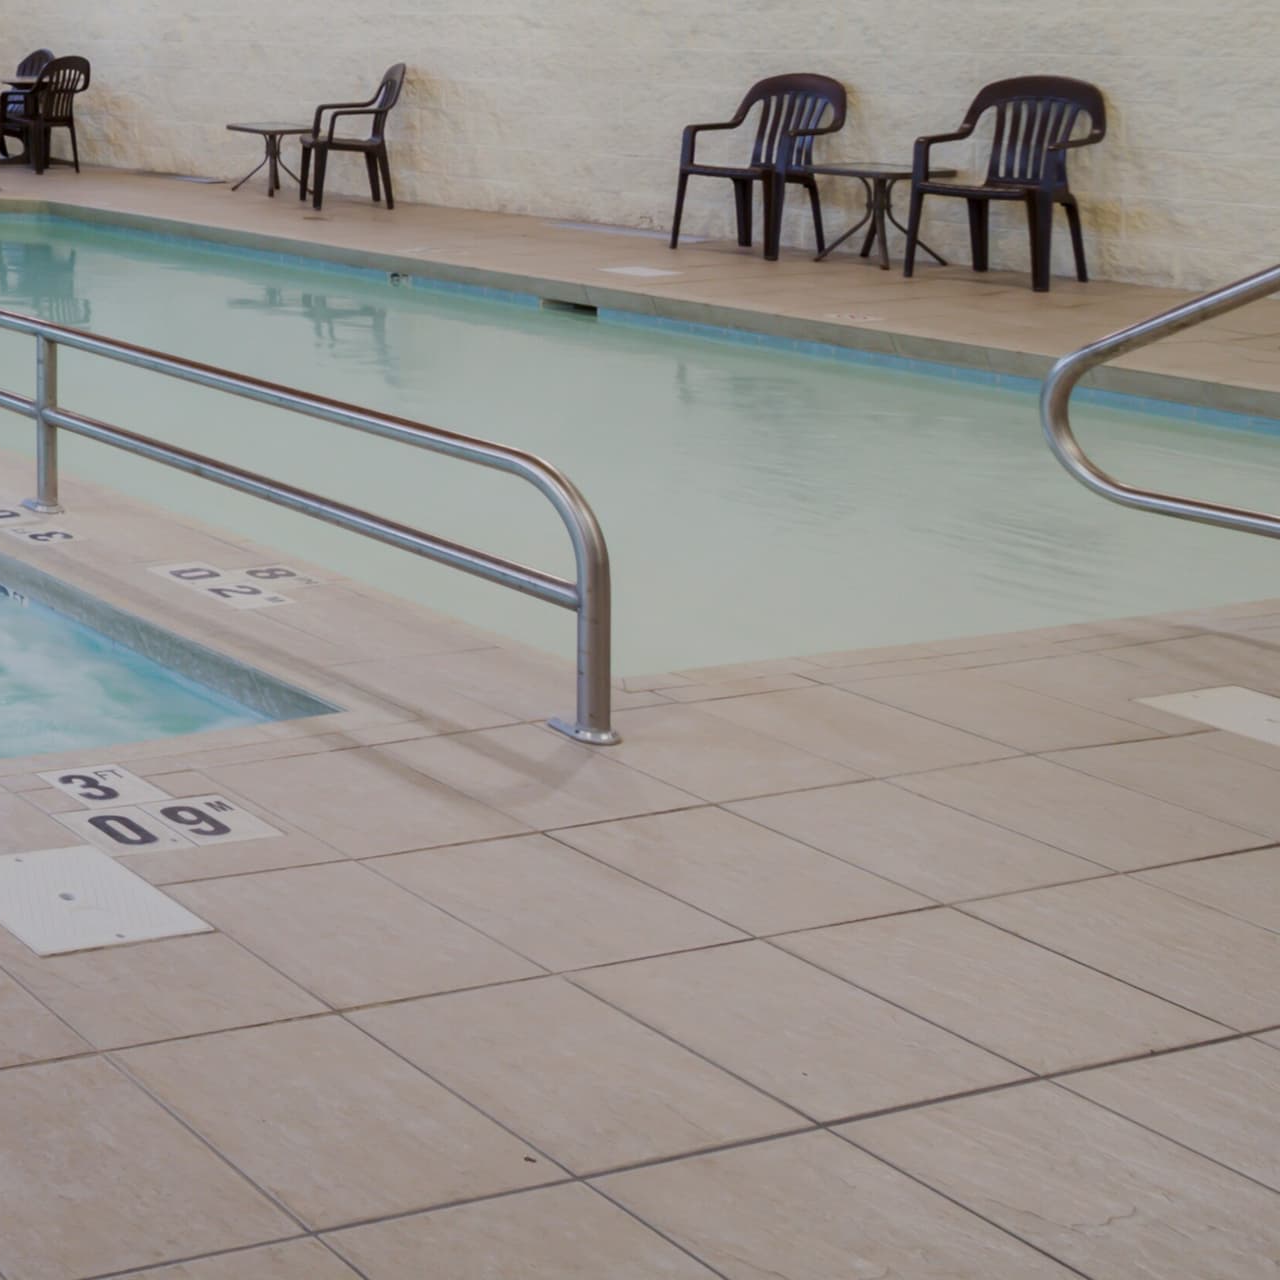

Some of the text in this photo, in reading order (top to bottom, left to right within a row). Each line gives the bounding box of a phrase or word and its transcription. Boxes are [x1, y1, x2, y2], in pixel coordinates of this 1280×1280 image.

[29, 531, 74, 542] 3
[58, 769, 123, 800] 3 FT
[204, 800, 235, 813] M
